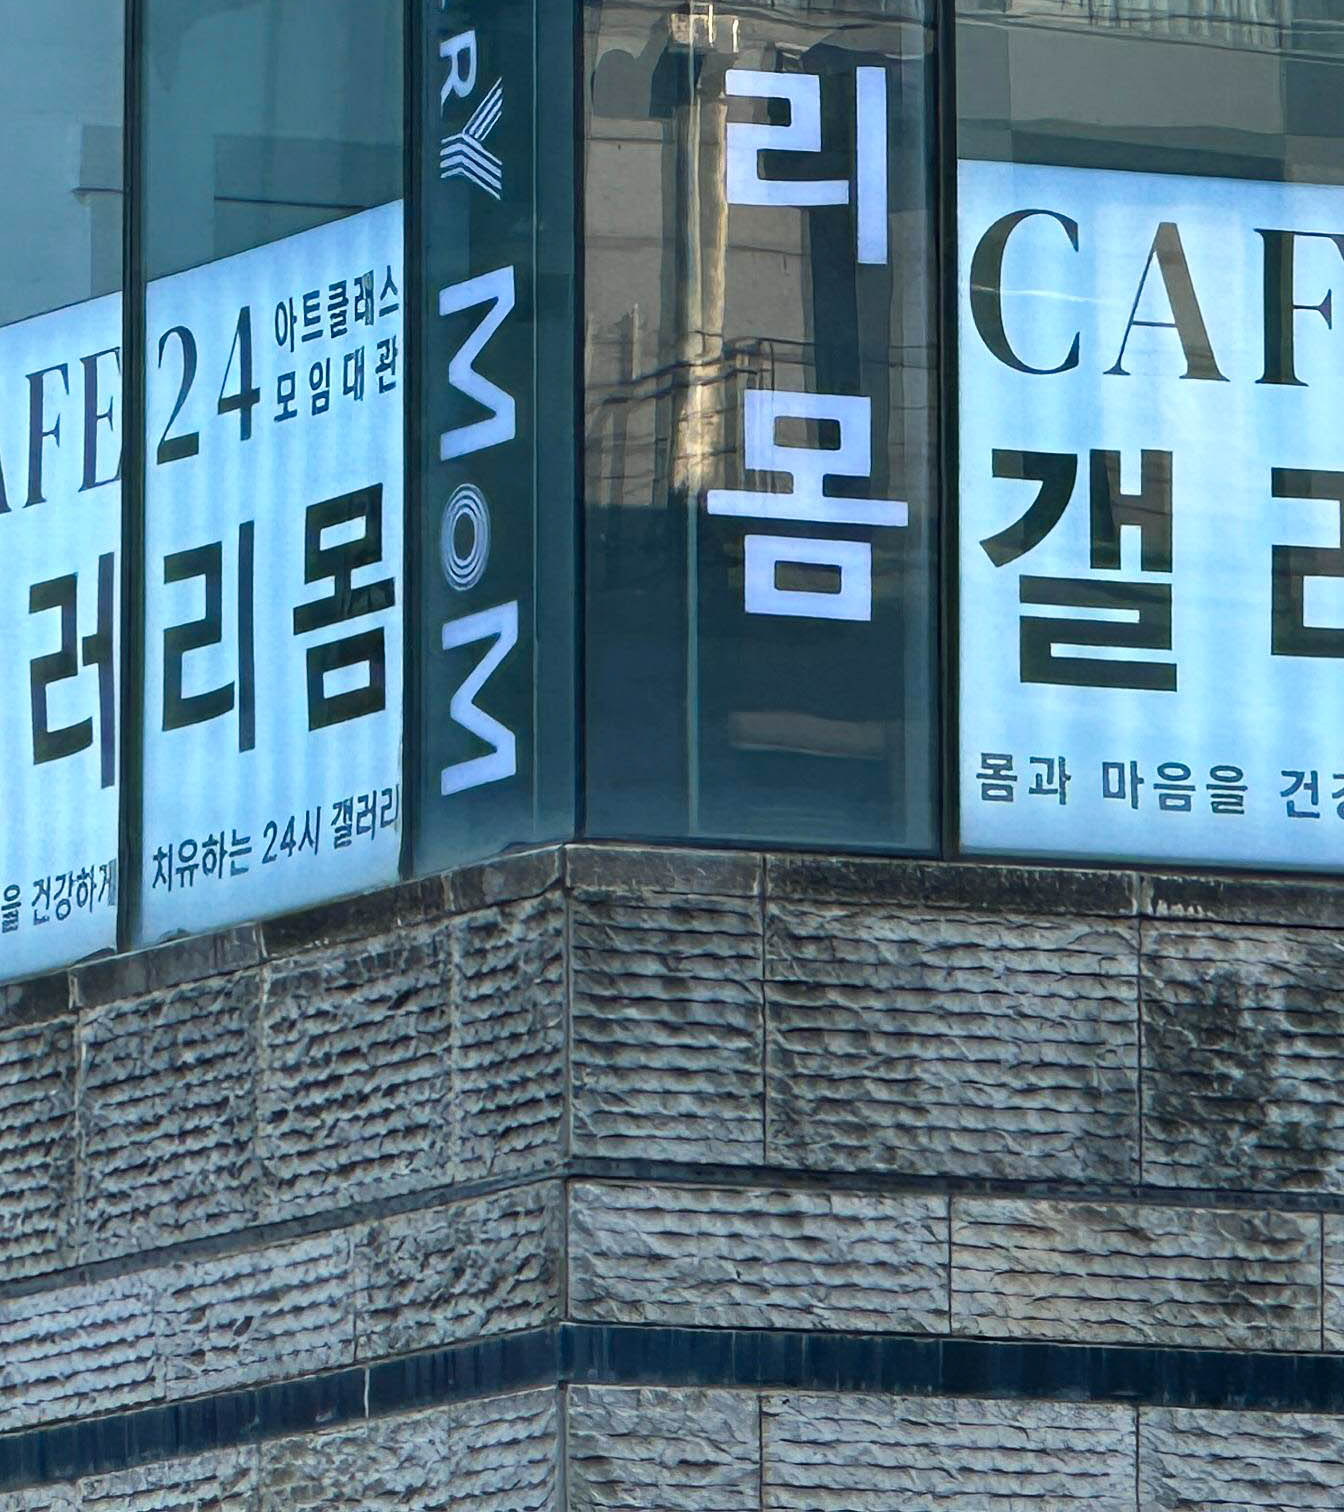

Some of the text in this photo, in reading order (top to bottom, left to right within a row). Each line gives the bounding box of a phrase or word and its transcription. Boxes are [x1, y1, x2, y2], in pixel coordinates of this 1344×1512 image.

[274, 265, 399, 352] 아트클래스
[156, 306, 260, 466] 24
[976, 753, 1071, 805] 몸과
[1102, 761, 1247, 814] 마음을
[33, 859, 116, 926] 건강하게
[152, 829, 252, 892] 치유하는
[263, 806, 321, 864] 24시
[330, 784, 399, 847] 갤러리
